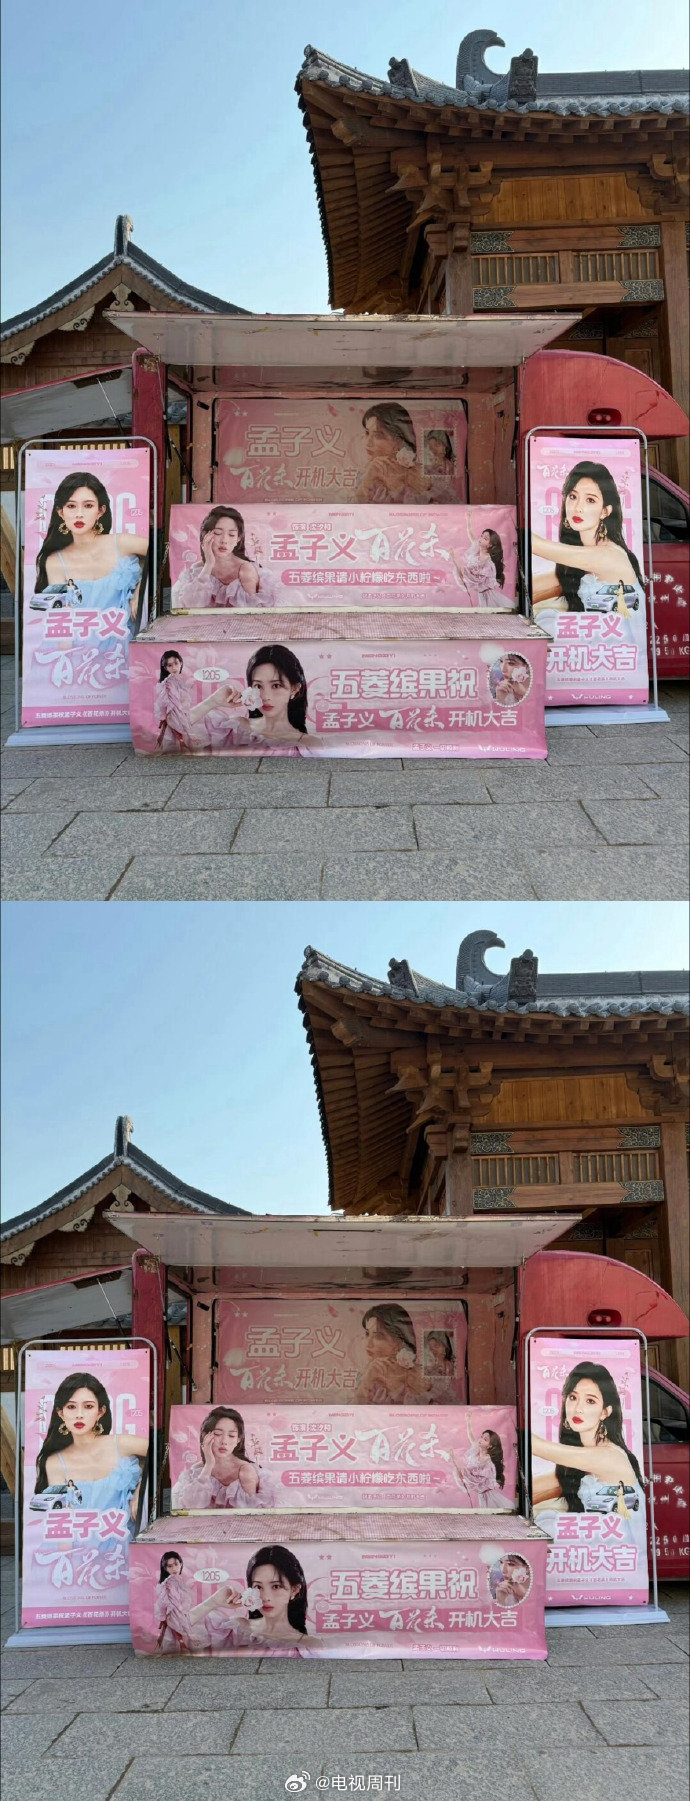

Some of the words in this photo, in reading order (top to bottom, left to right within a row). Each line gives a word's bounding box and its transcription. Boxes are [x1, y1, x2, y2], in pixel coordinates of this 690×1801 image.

[245, 424, 346, 459] 孟子义
[295, 465, 358, 489] 开机大吉
[270, 532, 358, 563] 孟子义
[44, 609, 127, 639] 孟子义
[556, 614, 624, 639] 孟子义
[546, 644, 638, 674] 开机大吉
[201, 669, 221, 681] 1205
[329, 667, 479, 700] 五菱缤果祝
[322, 711, 375, 729] 孟子义
[448, 709, 519, 728] 开机大吉
[245, 1325, 346, 1360] 孟子义
[295, 1366, 358, 1390] 开机大吉
[270, 1433, 358, 1464] 孟子义
[44, 1510, 127, 1540] 孟子义
[556, 1515, 624, 1540] 孟子义
[546, 1545, 638, 1575] 开机大吉
[201, 1570, 221, 1582] 1205
[329, 1568, 479, 1601] 五菱缤果祝
[322, 1612, 375, 1630] 孟子义
[448, 1610, 519, 1629] 开机大吉
